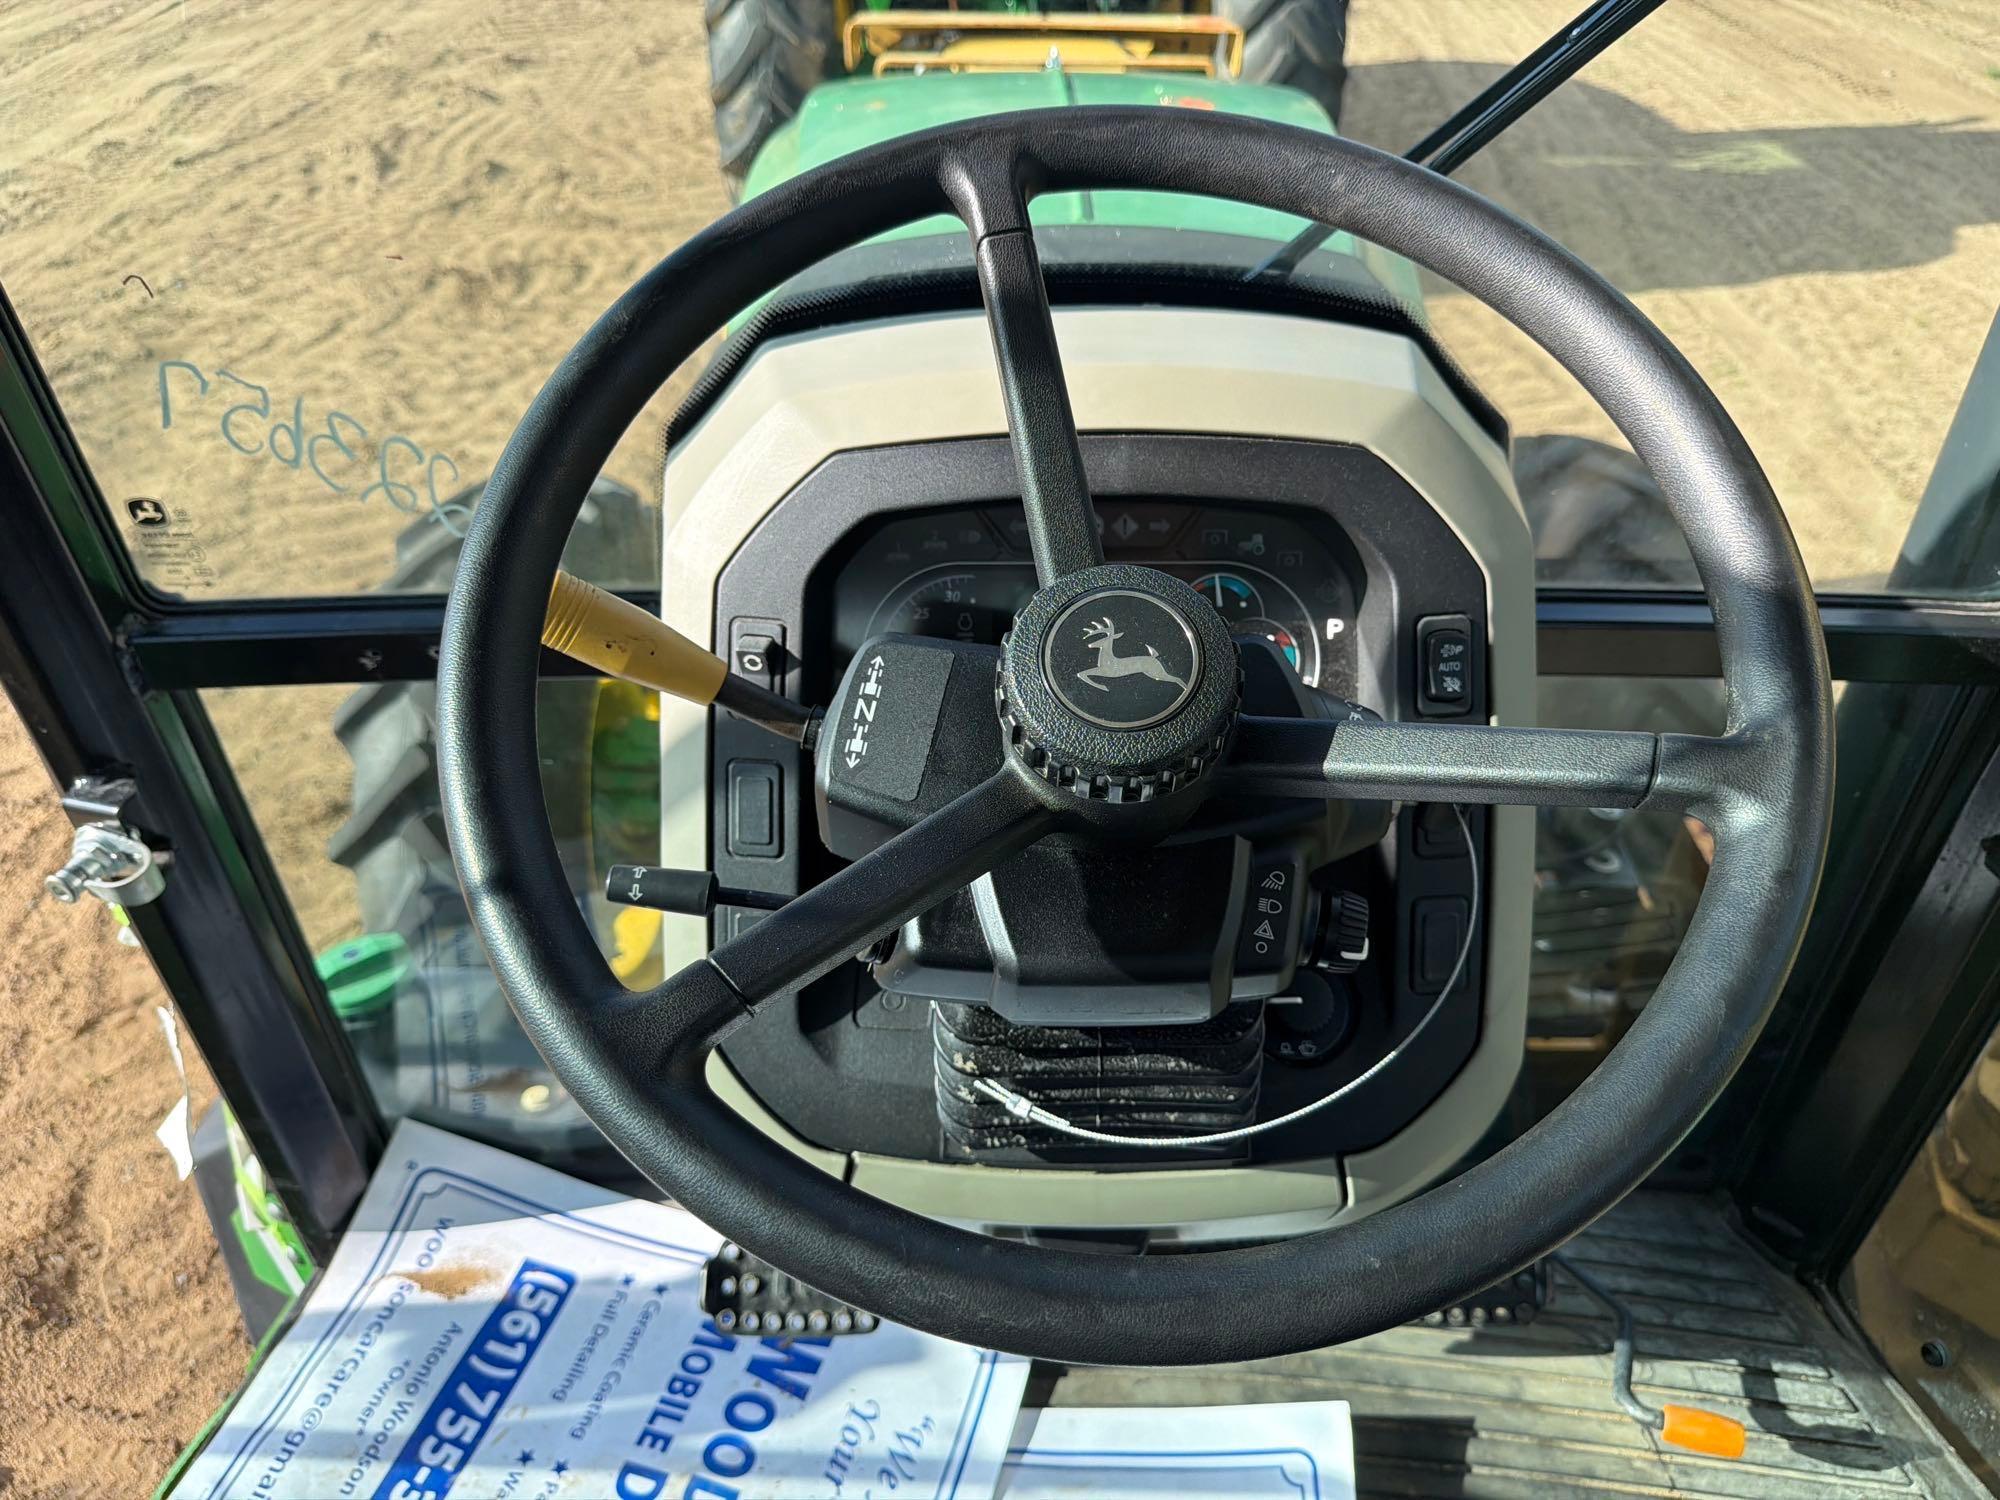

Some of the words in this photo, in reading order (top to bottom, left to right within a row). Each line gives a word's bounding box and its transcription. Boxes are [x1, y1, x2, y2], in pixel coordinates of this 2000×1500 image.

[912, 607, 931, 620] 25
[1326, 618, 1344, 640] P
[1439, 661, 1461, 672] AUTO
[853, 698, 877, 722] N
[468, 1270, 569, 1380] (561)
[601, 1289, 629, 1323] Full
[611, 1299, 662, 1370] Ceramic
[405, 1320, 464, 1397] Antonio
[552, 1323, 610, 1402] Detailing
[569, 1370, 622, 1441] Coating
[339, 1399, 414, 1496] Woodson
[824, 1398, 881, 1496] Your
